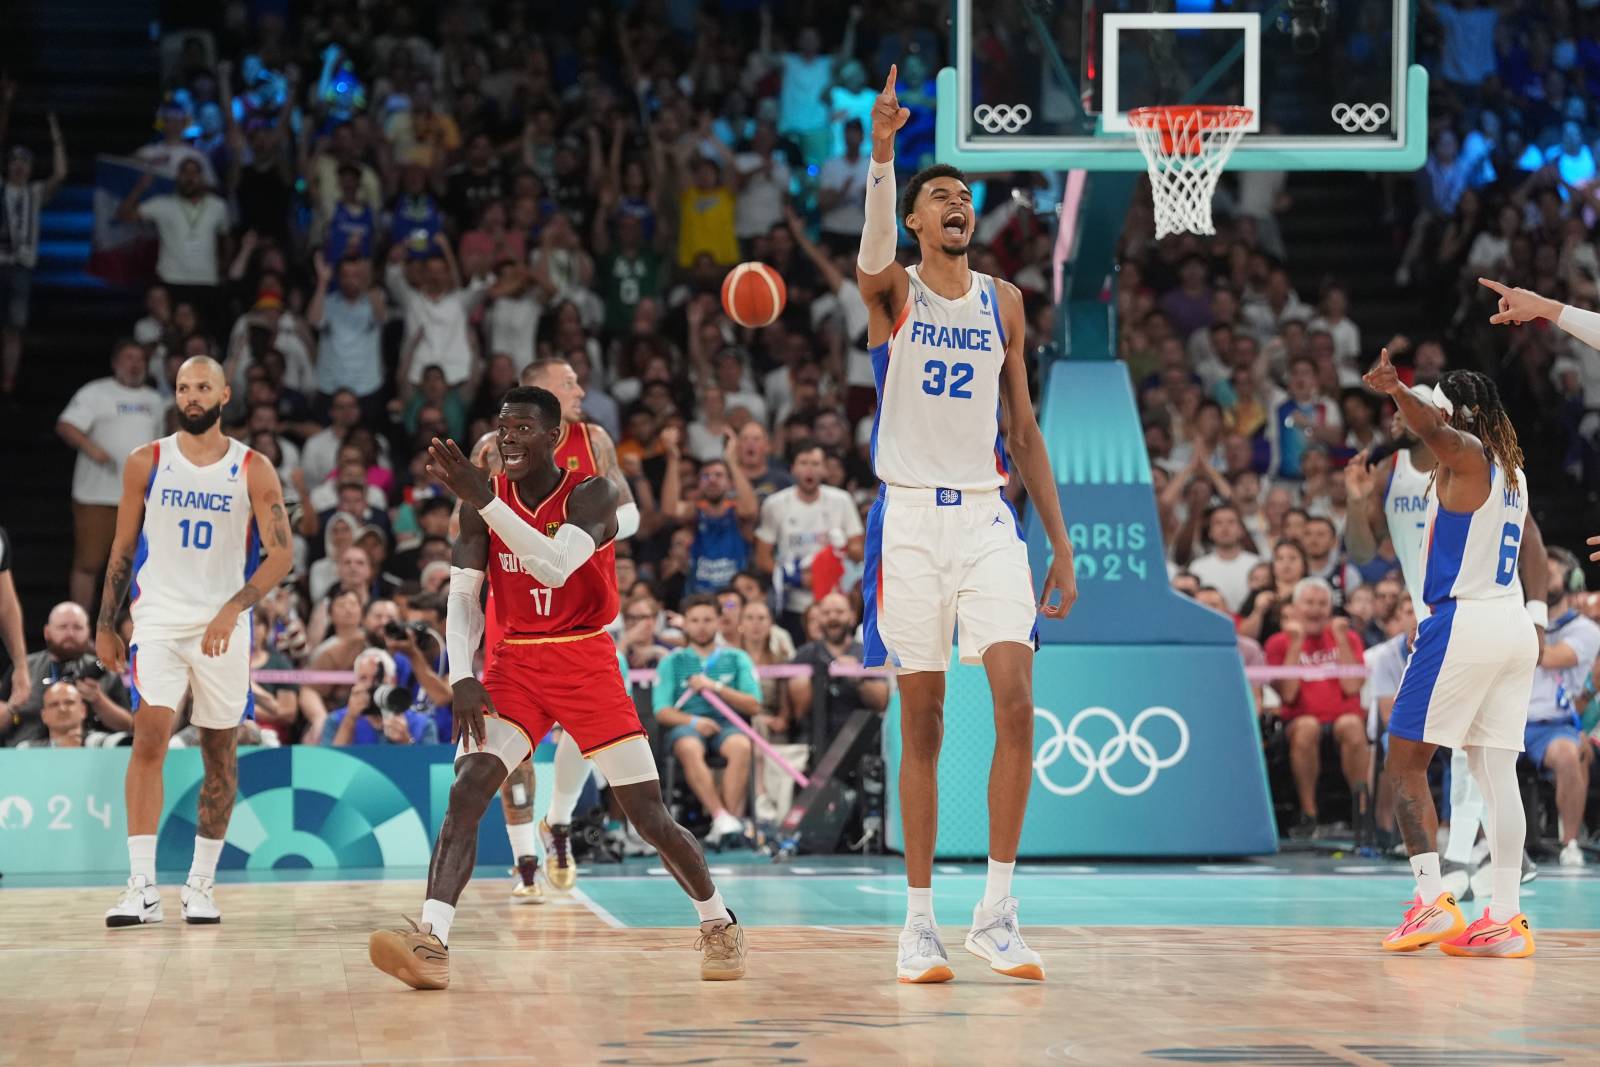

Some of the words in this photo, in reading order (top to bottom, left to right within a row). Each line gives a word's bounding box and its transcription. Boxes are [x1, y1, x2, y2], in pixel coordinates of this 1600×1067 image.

[911, 321, 992, 352] FRANCE
[922, 360, 974, 399] 32
[161, 489, 233, 512] FRANCE
[178, 519, 213, 550] 10
[1046, 522, 1146, 550] ARIS
[1046, 553, 1147, 580] 024
[1495, 521, 1521, 586] 6
[530, 588, 552, 616] 17
